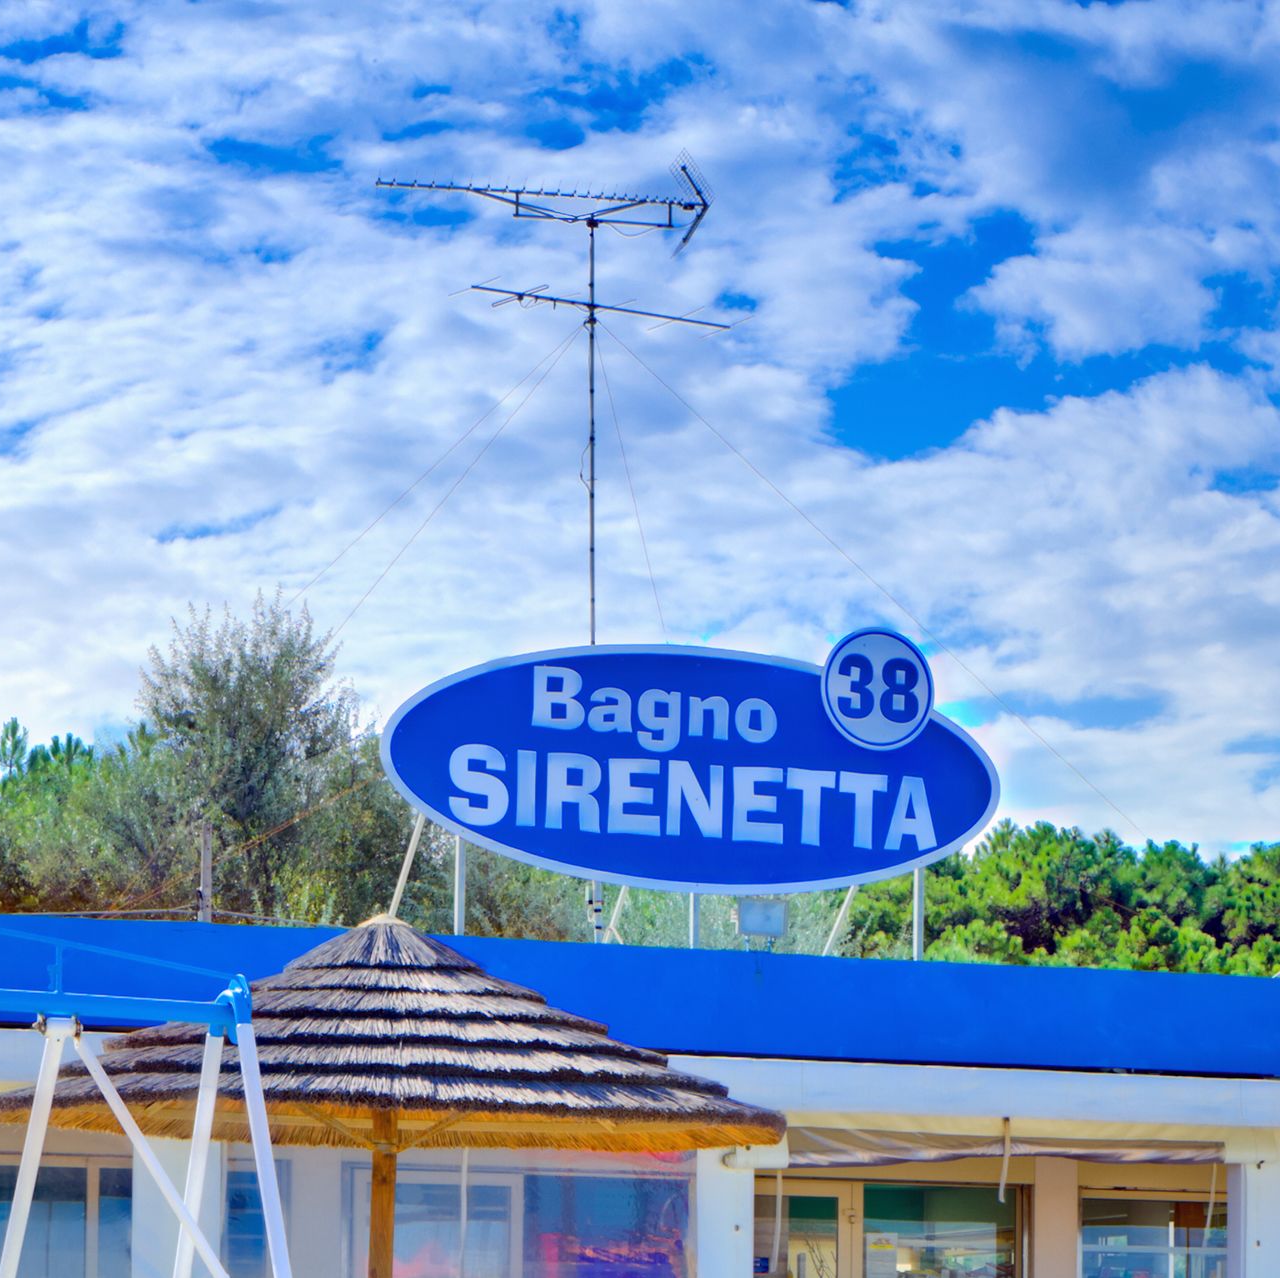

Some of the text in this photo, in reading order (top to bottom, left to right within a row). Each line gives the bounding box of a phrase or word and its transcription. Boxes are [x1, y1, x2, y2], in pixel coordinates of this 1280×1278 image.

[531, 665, 777, 752] Bagno
[836, 653, 920, 724] 38
[448, 743, 938, 851] SIRENETTA
